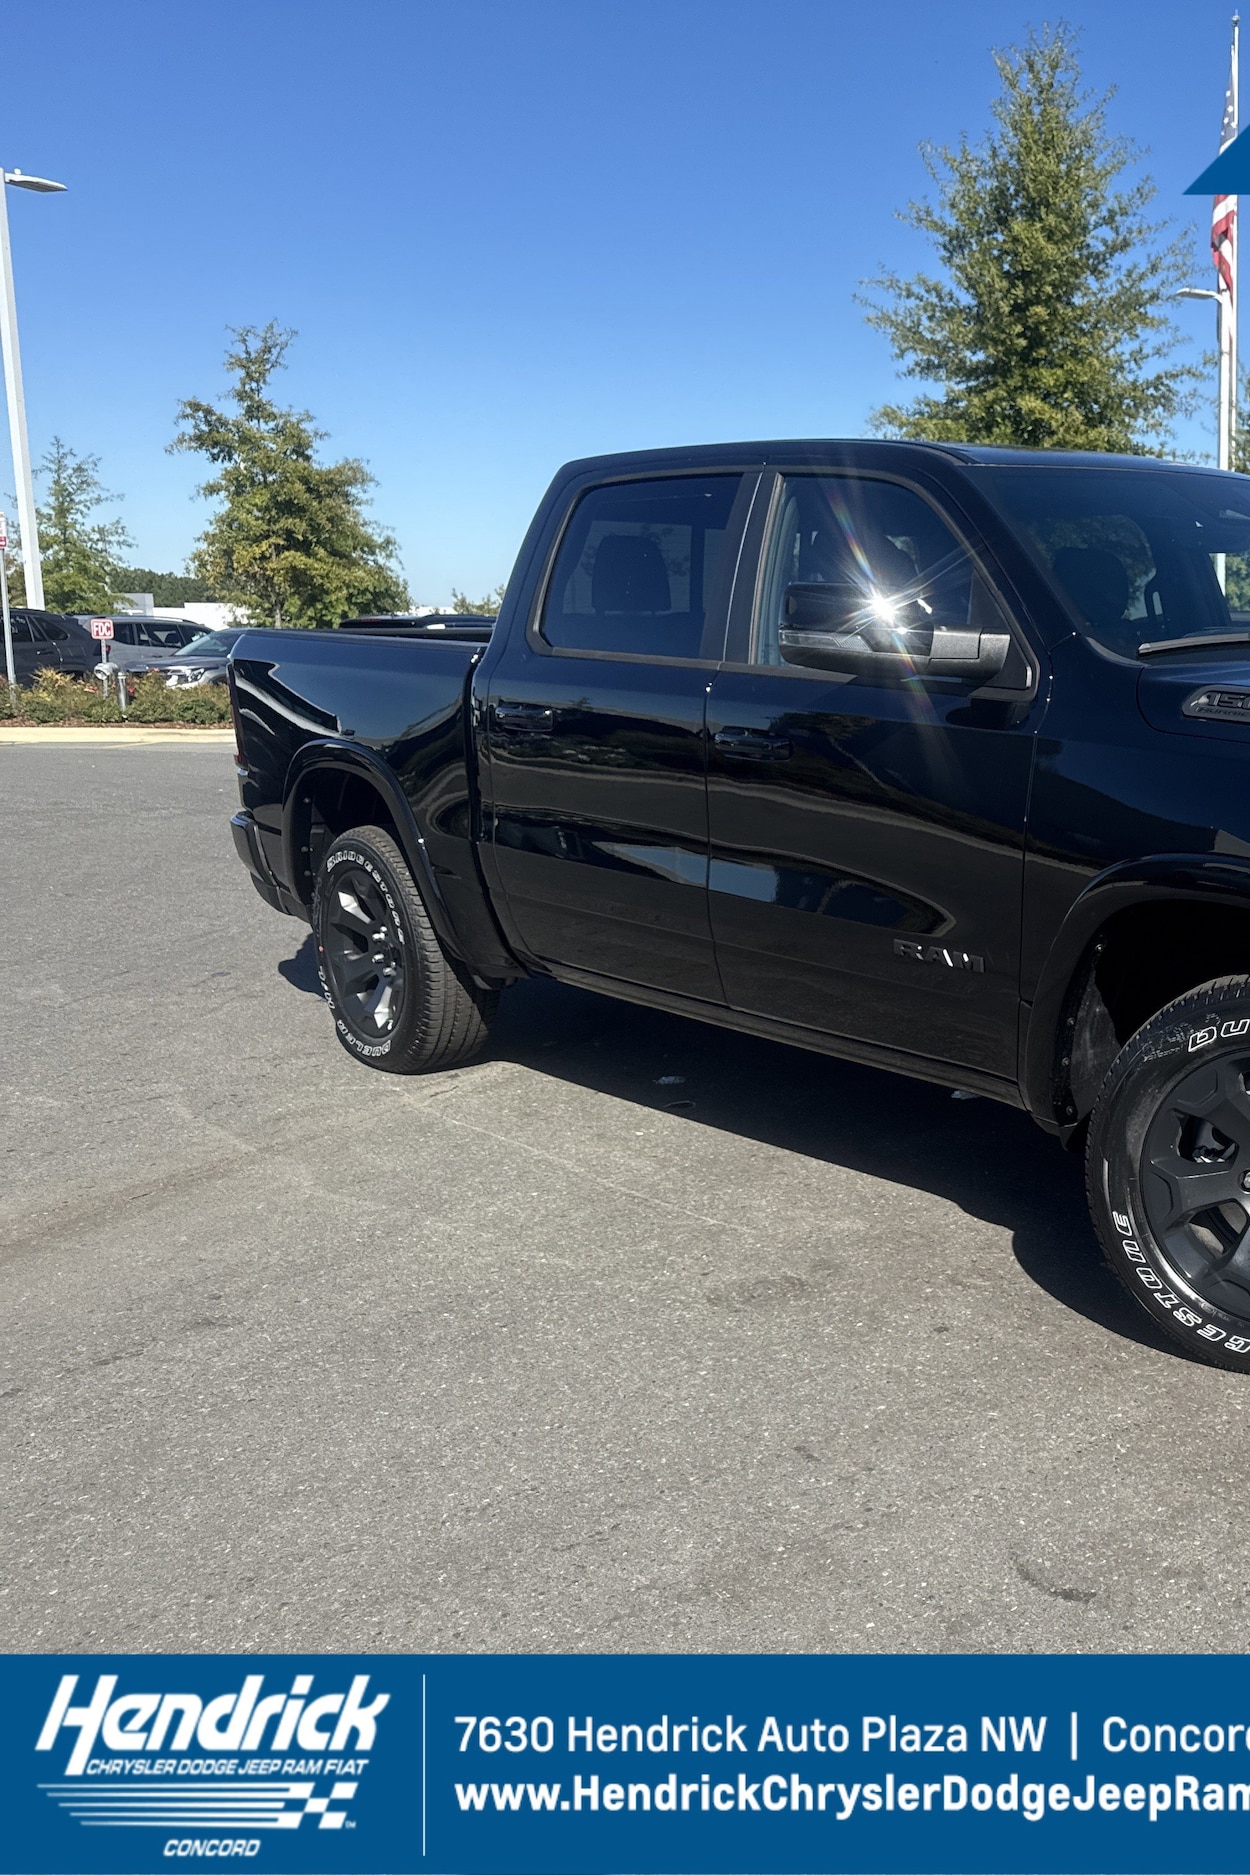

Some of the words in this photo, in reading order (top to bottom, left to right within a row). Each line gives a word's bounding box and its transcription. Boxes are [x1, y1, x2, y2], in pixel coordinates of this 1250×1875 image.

[93, 622, 112, 637] FDC
[326, 850, 405, 945] BRIDGESTONE
[893, 938, 985, 973] RAM
